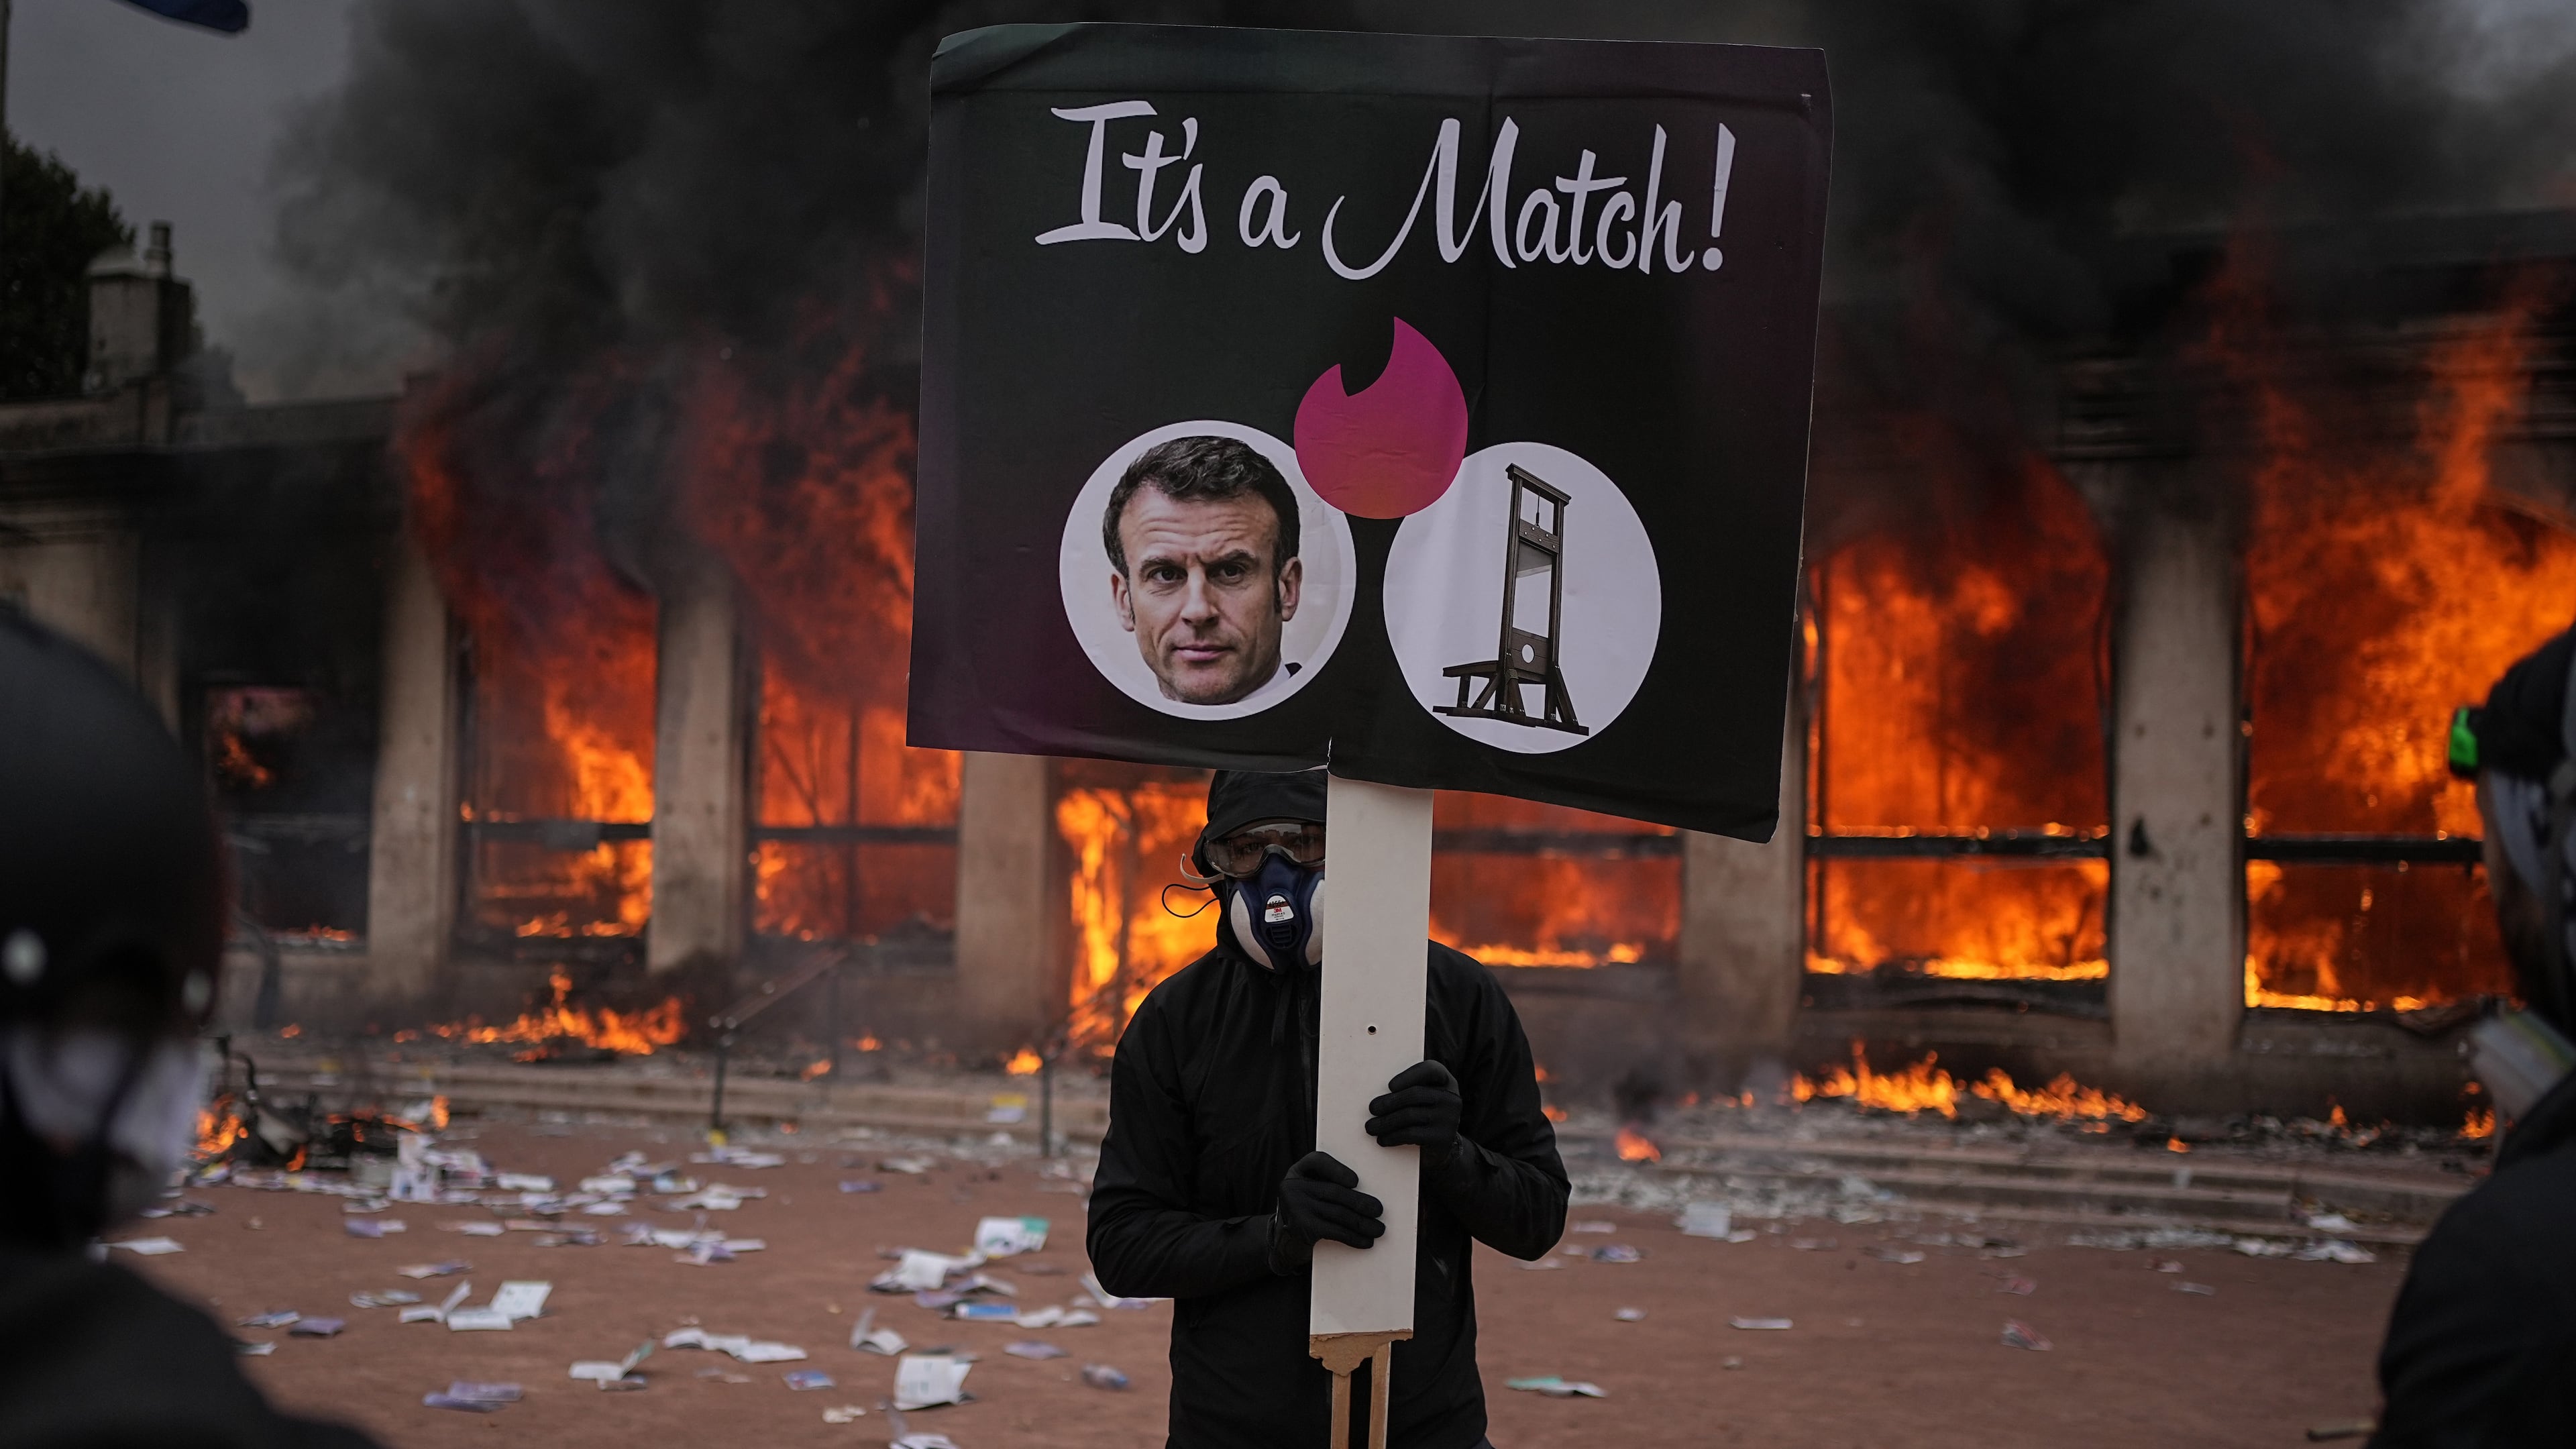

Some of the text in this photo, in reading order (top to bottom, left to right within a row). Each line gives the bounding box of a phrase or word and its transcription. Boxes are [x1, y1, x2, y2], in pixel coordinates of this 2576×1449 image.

[1034, 100, 1736, 280] It's a Match!
